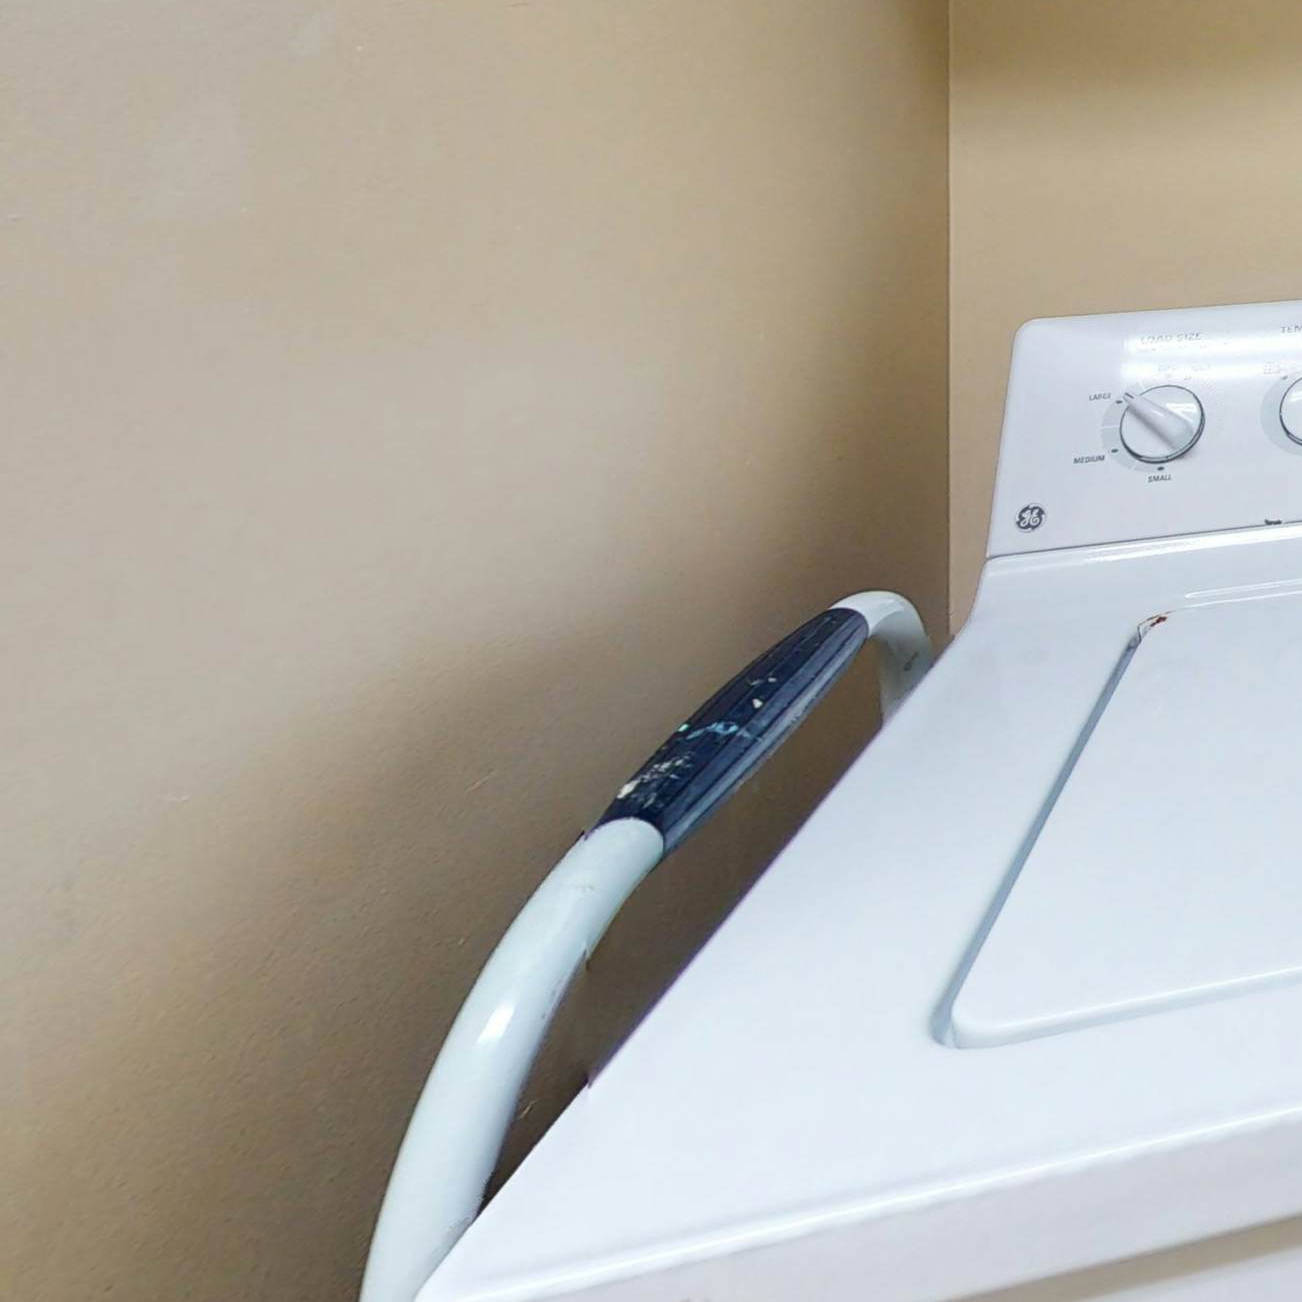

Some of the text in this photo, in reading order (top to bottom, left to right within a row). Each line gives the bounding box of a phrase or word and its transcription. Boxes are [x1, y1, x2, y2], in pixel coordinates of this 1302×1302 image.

[1176, 331, 1203, 342] SIZE
[1073, 454, 1106, 465] MEDIUM
[1147, 474, 1173, 484] SMALL
